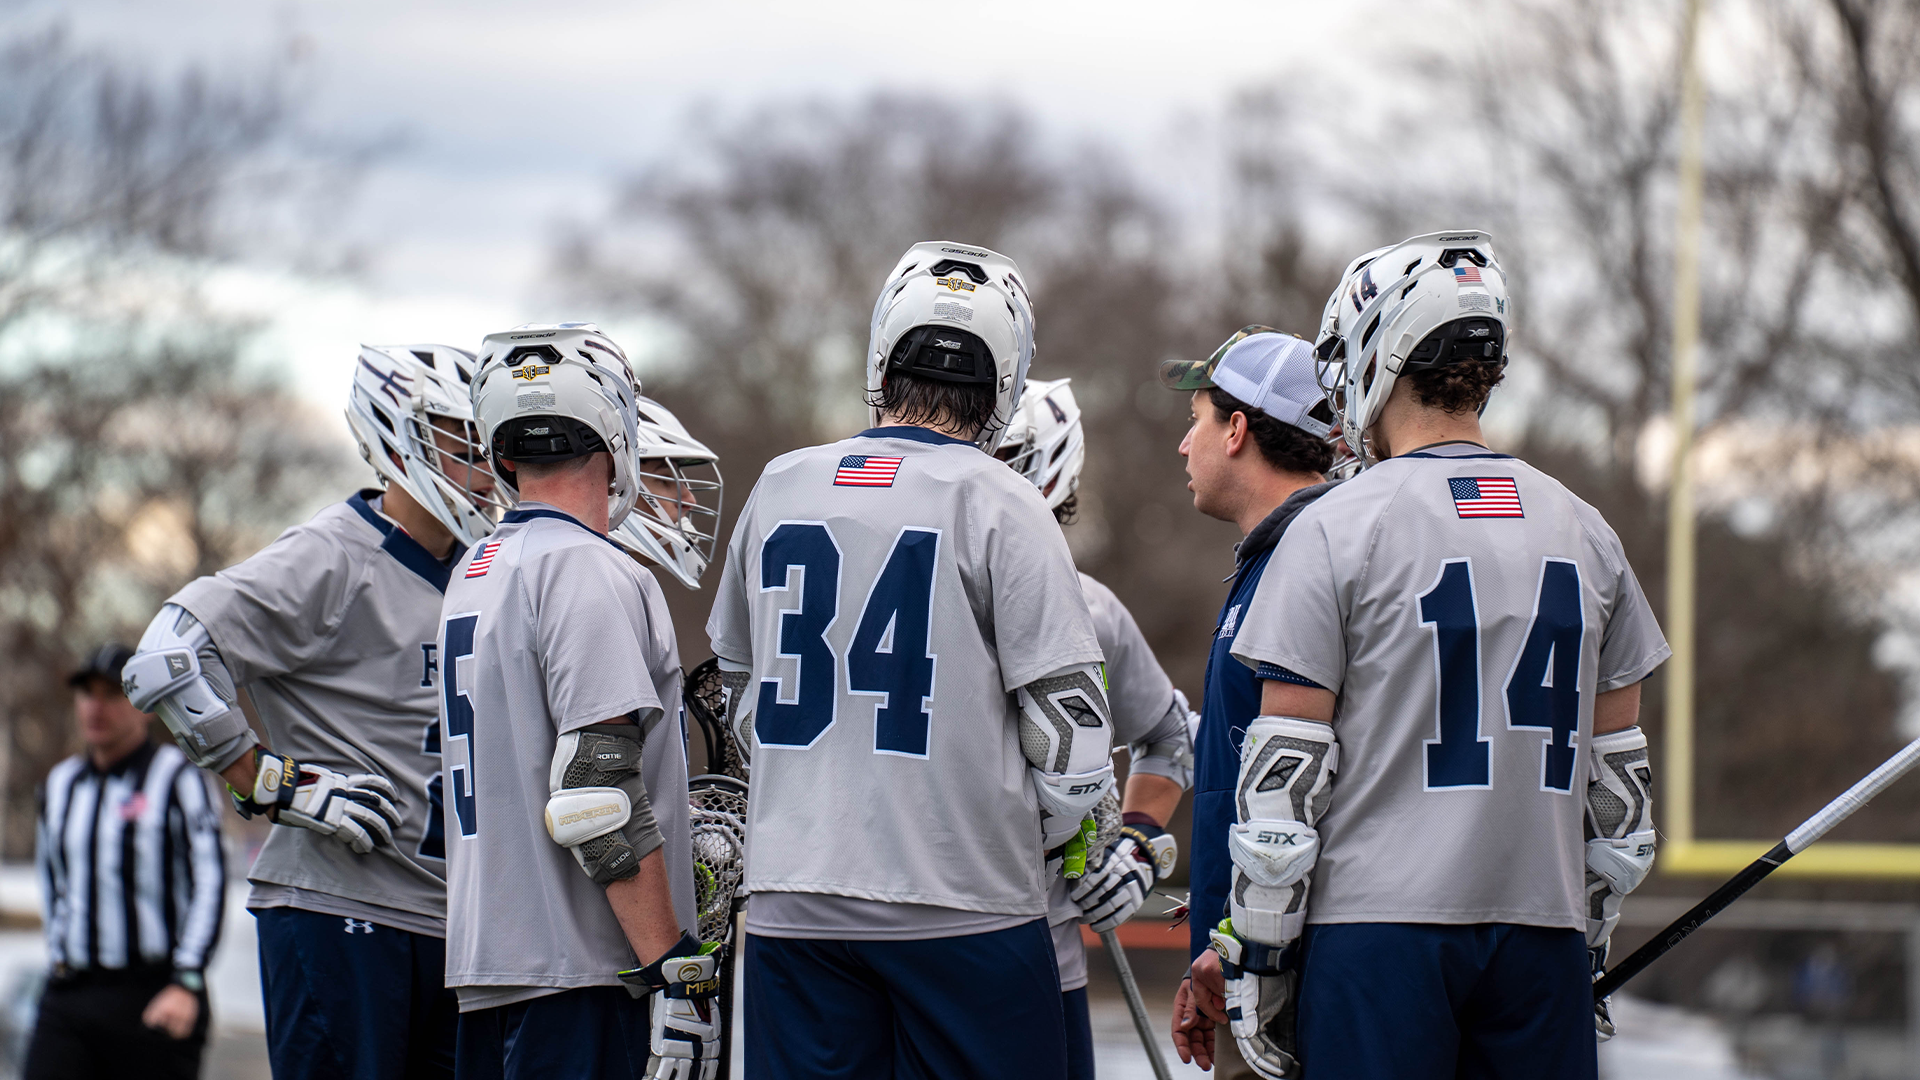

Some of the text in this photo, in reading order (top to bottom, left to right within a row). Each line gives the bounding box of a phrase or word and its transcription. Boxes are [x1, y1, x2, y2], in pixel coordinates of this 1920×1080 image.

[941, 247, 988, 258] cascade
[1349, 268, 1378, 315] 14
[510, 332, 556, 340] cascade
[753, 519, 943, 761] 34
[1415, 556, 1586, 796] 14
[443, 610, 481, 841] 5
[1067, 778, 1104, 795] STX
[559, 803, 622, 826] MAVERIK
[1256, 831, 1298, 846] STX
